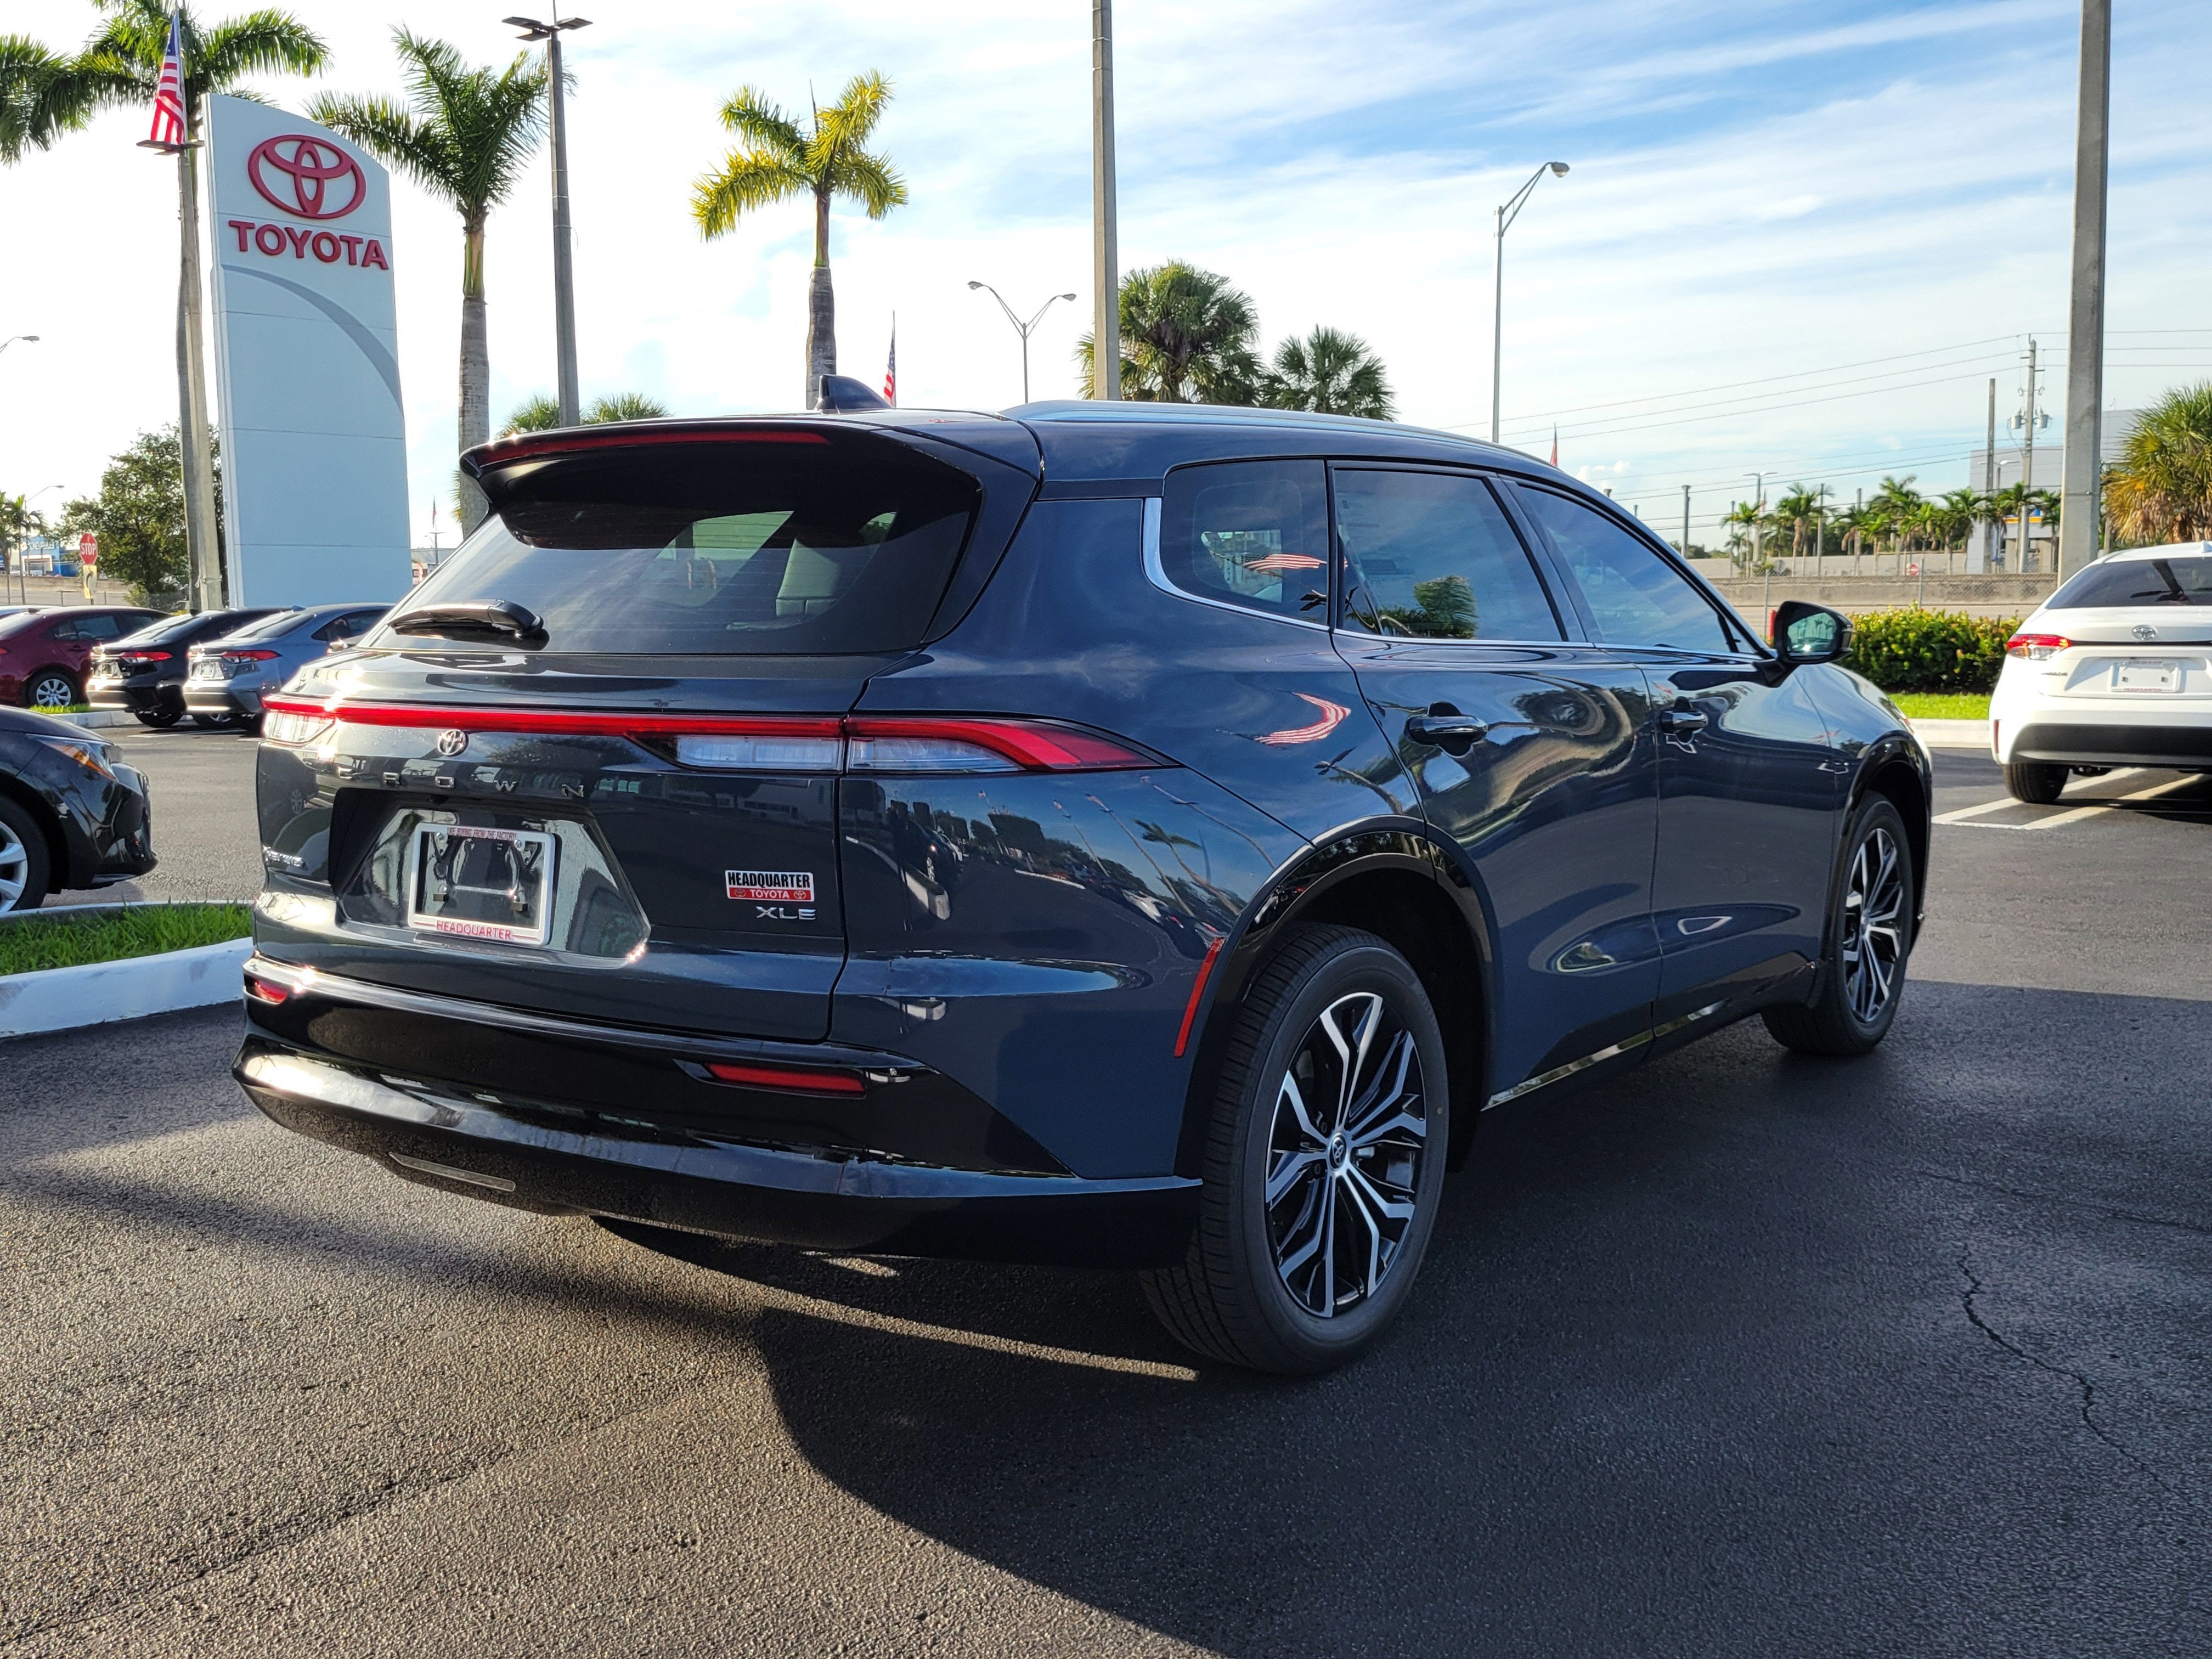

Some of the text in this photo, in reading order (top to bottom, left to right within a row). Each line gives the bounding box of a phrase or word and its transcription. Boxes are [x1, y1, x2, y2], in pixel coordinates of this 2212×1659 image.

[229, 220, 389, 269] TOYOTA
[81, 543, 96, 555] STOP
[728, 872, 810, 888] HEADQUARTER
[749, 889, 790, 899] TOYOTA
[756, 906, 816, 920] XLE
[436, 920, 512, 940] HEADQUARTER
